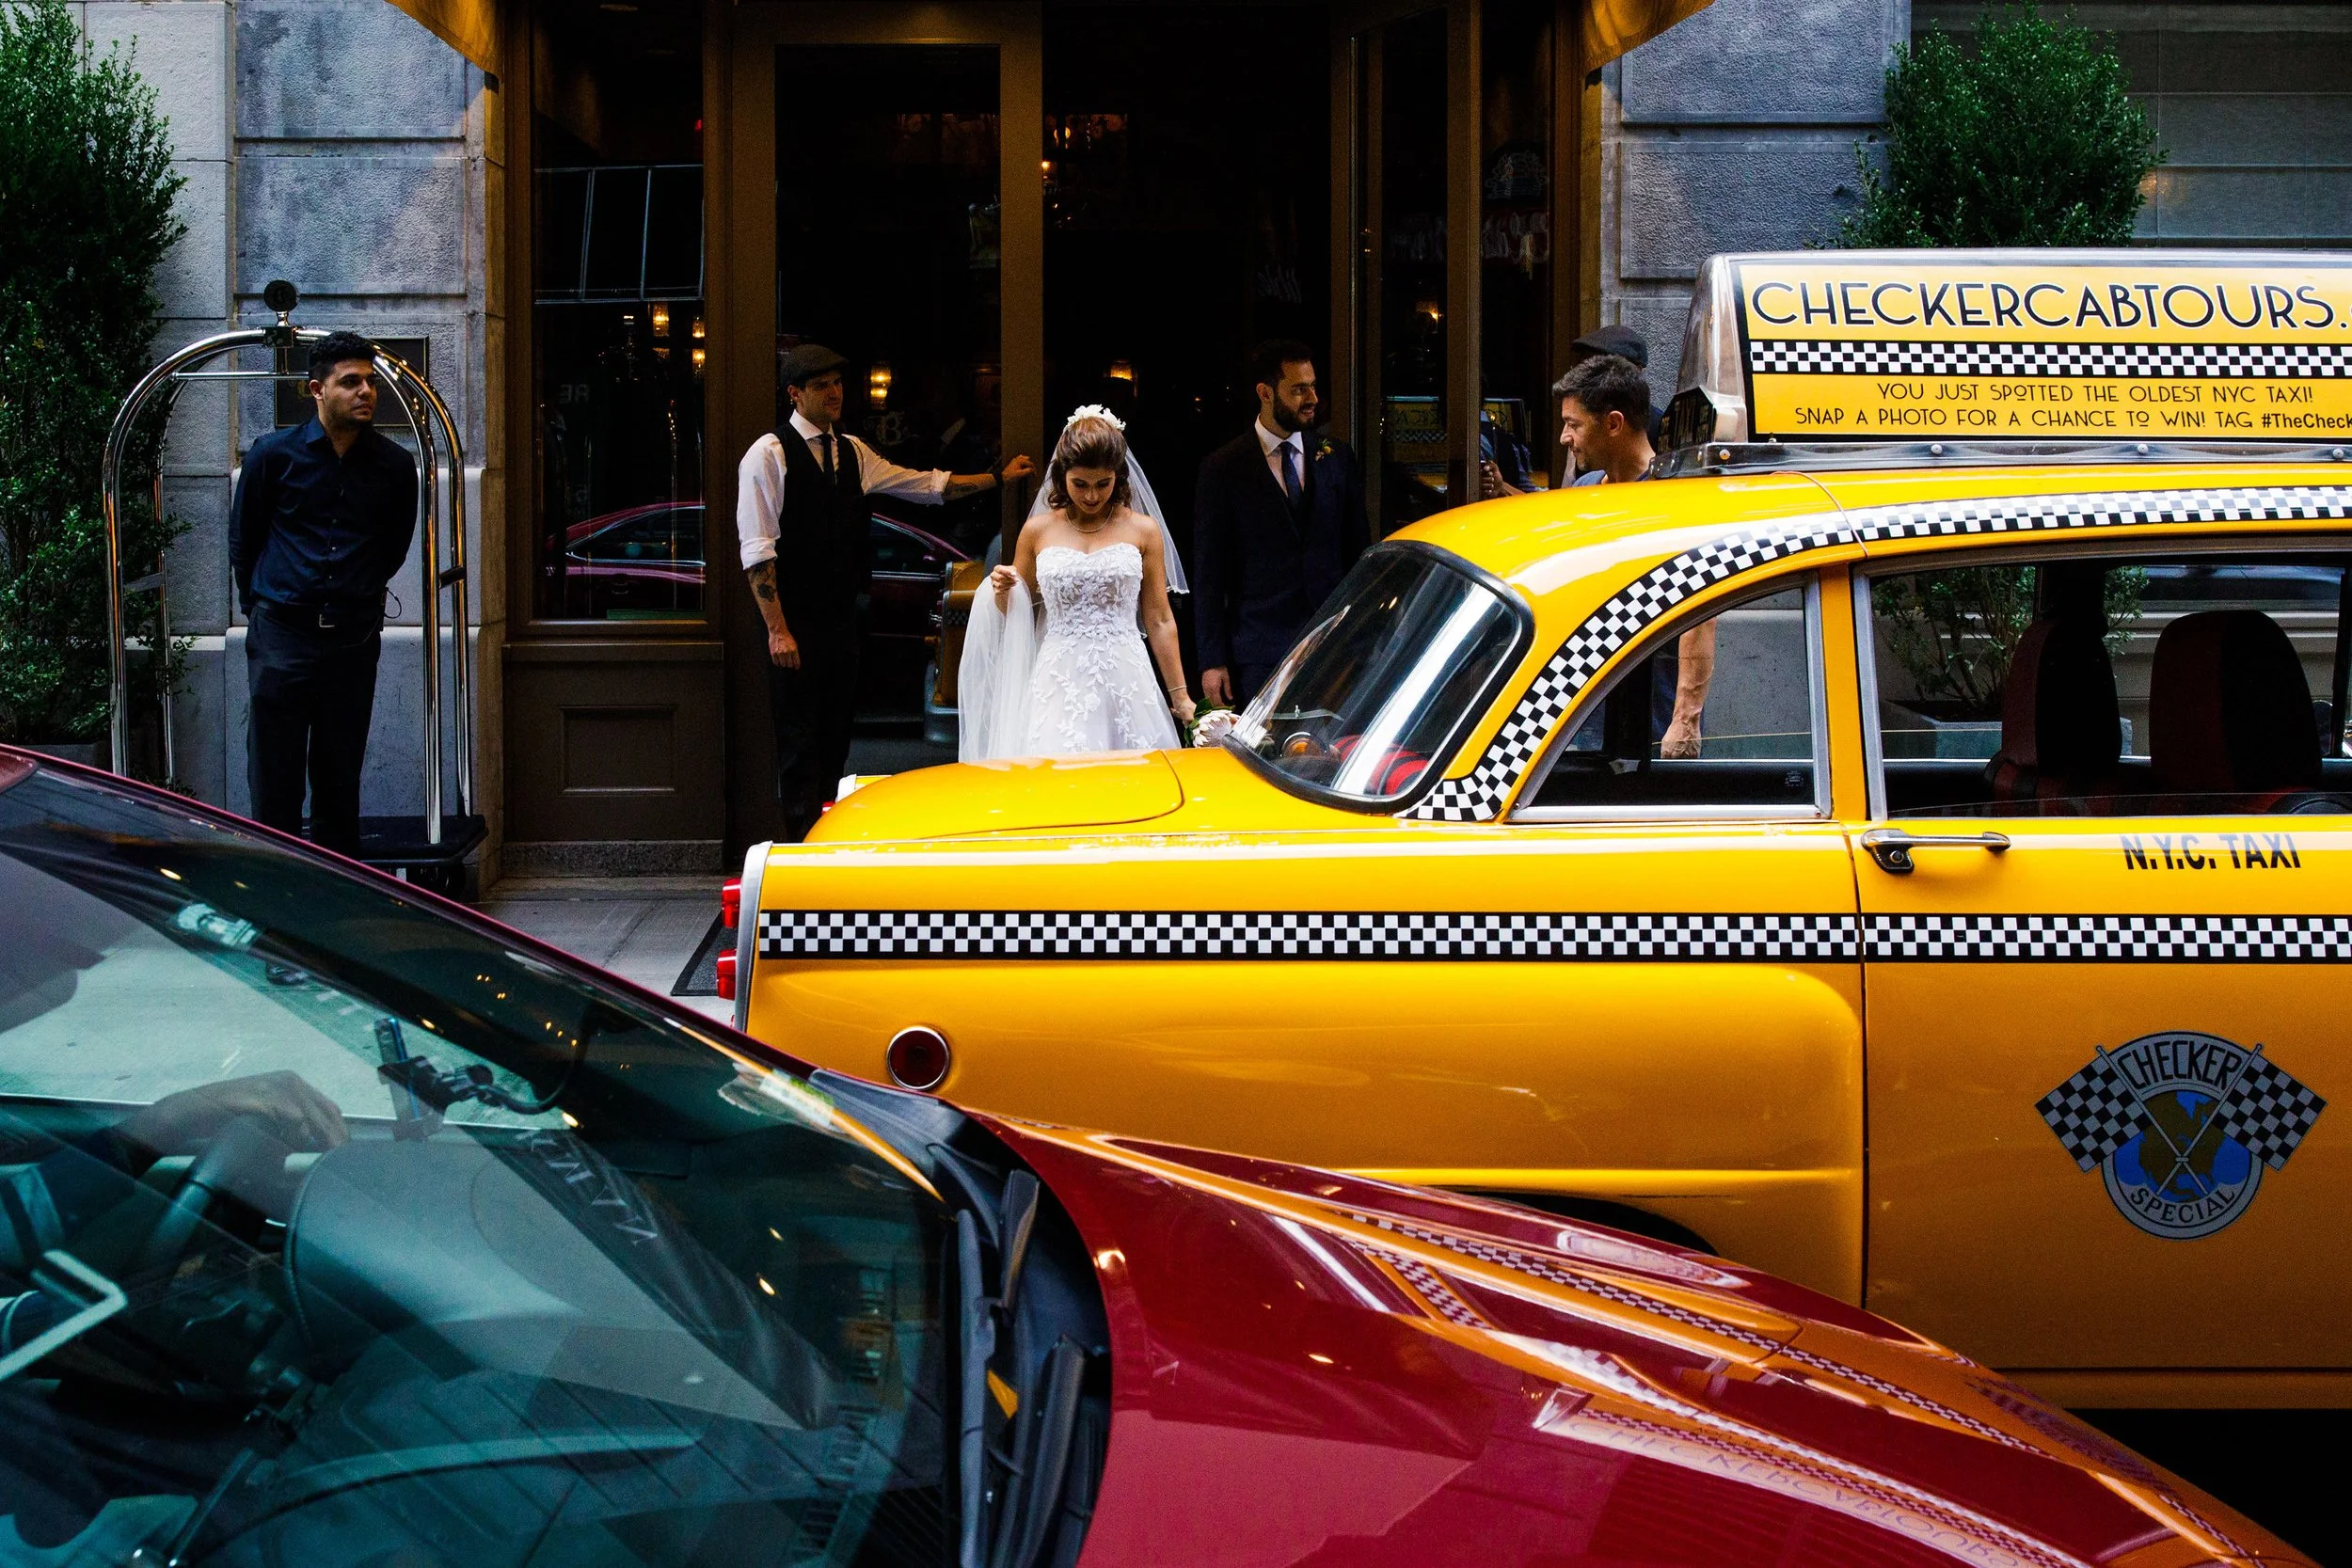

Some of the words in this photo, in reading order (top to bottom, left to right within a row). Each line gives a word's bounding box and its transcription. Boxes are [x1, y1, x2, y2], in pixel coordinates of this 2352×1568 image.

[1752, 282, 2352, 329] CHECKERCABTOURS.
[1877, 383, 1924, 400] YOU
[1934, 383, 1979, 401] JUST
[1990, 384, 2074, 402] SPOTTED
[2083, 385, 2120, 403] THE
[2129, 386, 2202, 403] OLDEST
[2212, 386, 2256, 403] NYC
[2265, 386, 2313, 404] TAXI!
[1795, 407, 1845, 425] SNAP
[1855, 409, 1868, 425] A
[1878, 408, 1947, 426] PHOTO
[1956, 408, 1997, 426] FOR
[2009, 411, 2022, 427] A
[2031, 409, 2117, 427] CHANCE
[2125, 410, 2150, 427] TO
[2160, 410, 2206, 428] WIN!
[2215, 411, 2253, 428] TAG
[2120, 833, 2217, 870] N.Y.C.
[2217, 833, 2301, 869] TAXI
[2117, 1039, 2242, 1090] CHECKER
[2130, 1186, 2235, 1223] SPECIAL
